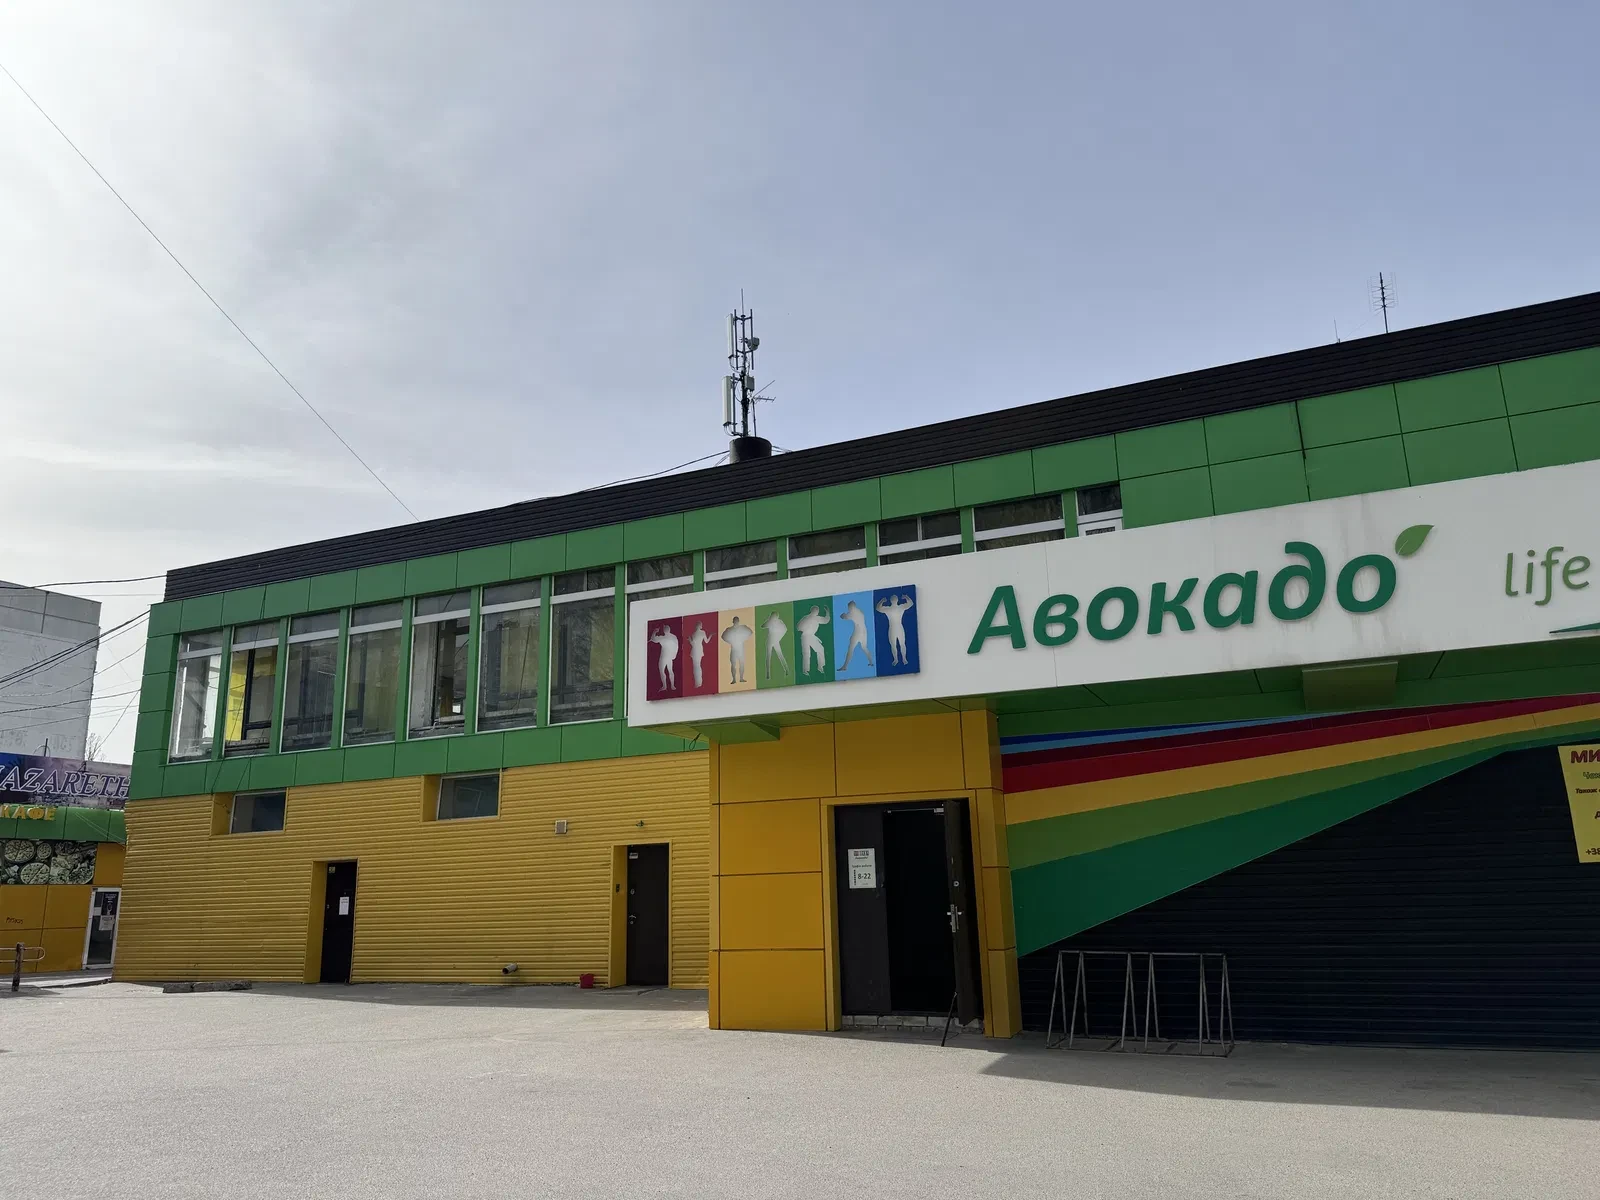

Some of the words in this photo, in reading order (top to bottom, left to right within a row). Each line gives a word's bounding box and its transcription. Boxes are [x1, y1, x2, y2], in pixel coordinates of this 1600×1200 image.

[967, 541, 1397, 654] Авокадо
[1505, 546, 1590, 606] life
[0, 764, 130, 799] AZARETH
